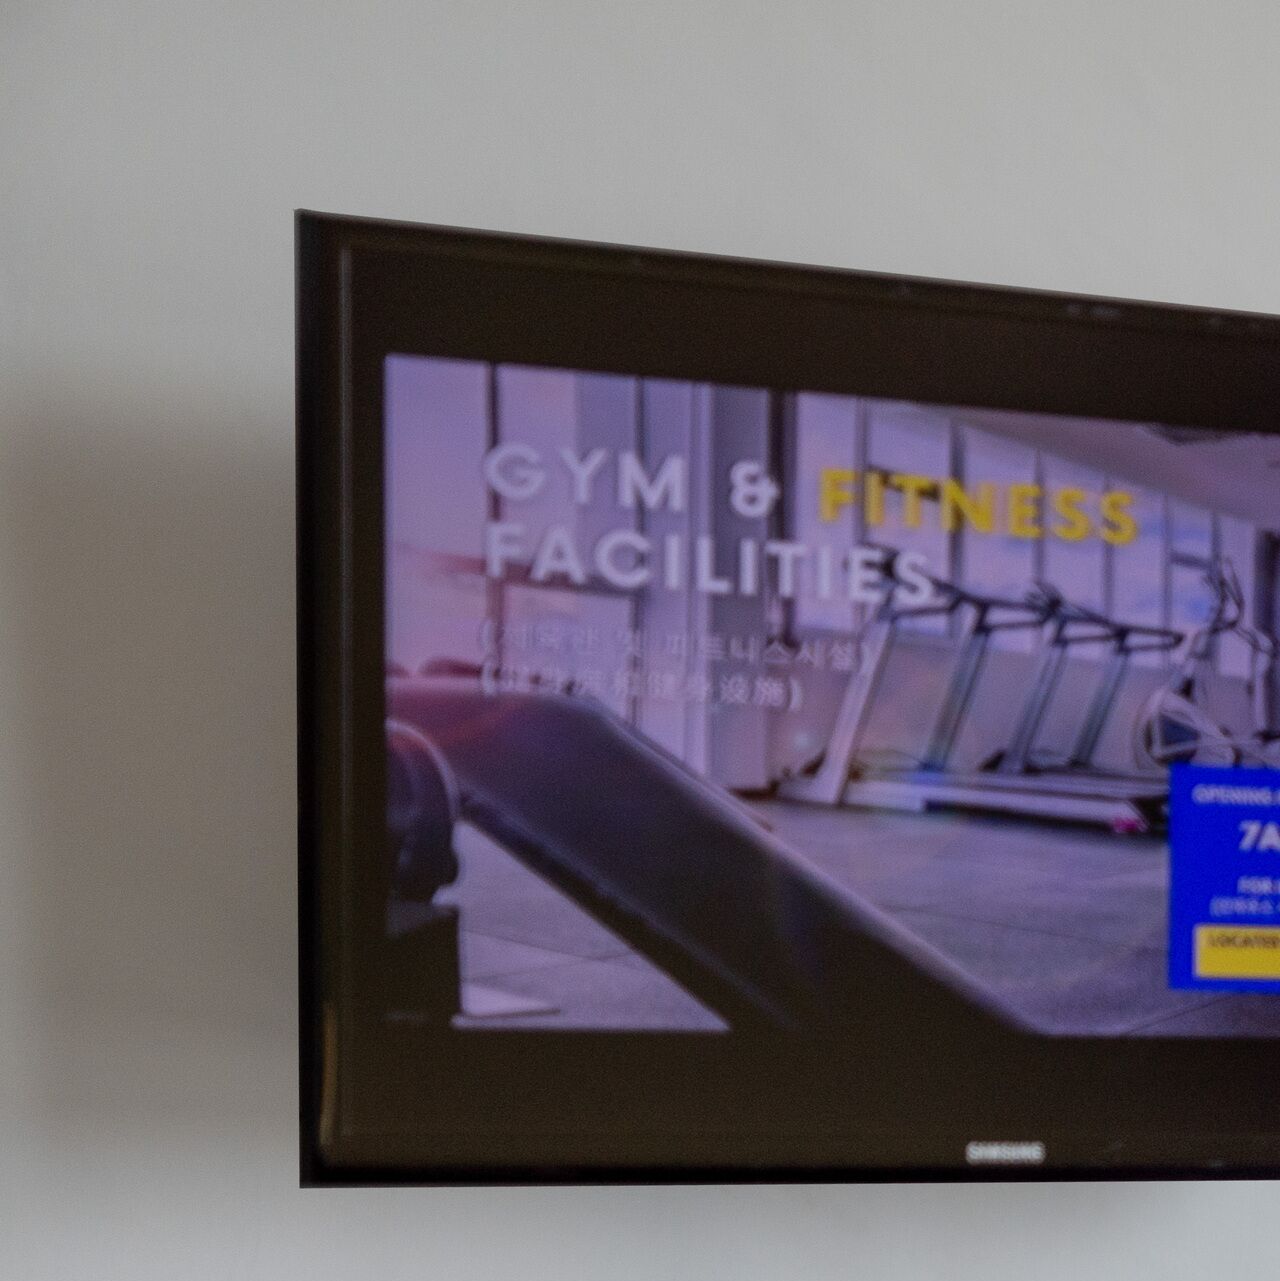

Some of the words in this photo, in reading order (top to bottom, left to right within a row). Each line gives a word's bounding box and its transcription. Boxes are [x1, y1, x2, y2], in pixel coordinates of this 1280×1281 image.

[485, 443, 688, 512] GYM
[730, 460, 779, 518] &
[818, 468, 1138, 545] FITNESS
[485, 522, 935, 602] FACILITIES
